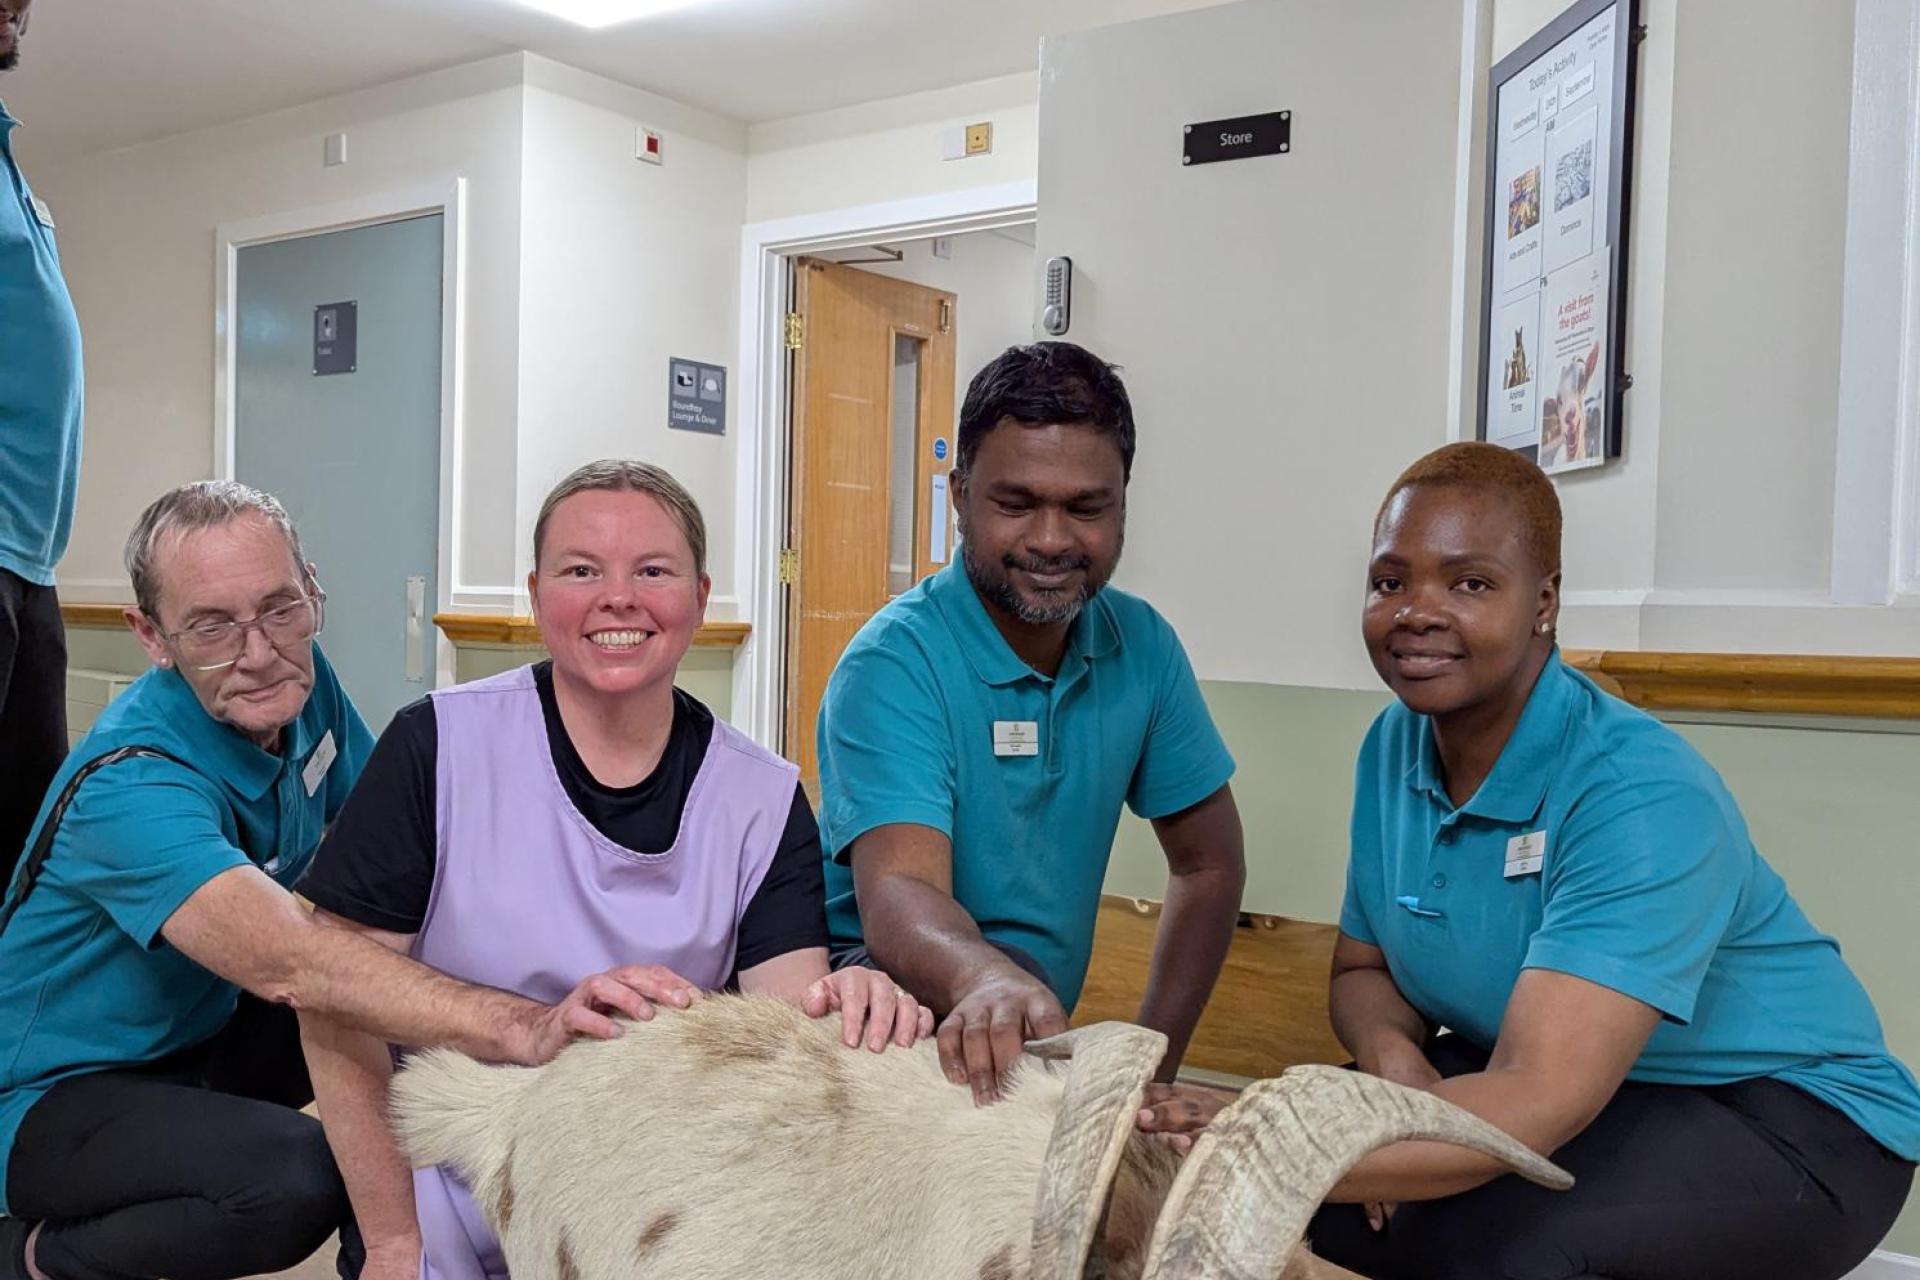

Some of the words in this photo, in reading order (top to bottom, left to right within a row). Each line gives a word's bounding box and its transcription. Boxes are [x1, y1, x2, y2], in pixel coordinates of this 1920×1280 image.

[1528, 66, 1553, 91] Today's
[1553, 51, 1577, 75] Activity
[1220, 133, 1253, 146] Store
[1564, 297, 1577, 313] visit
[1578, 293, 1594, 306] from
[1559, 316, 1570, 329] the
[672, 410, 694, 423] Lounge
[695, 414, 700, 423] &
